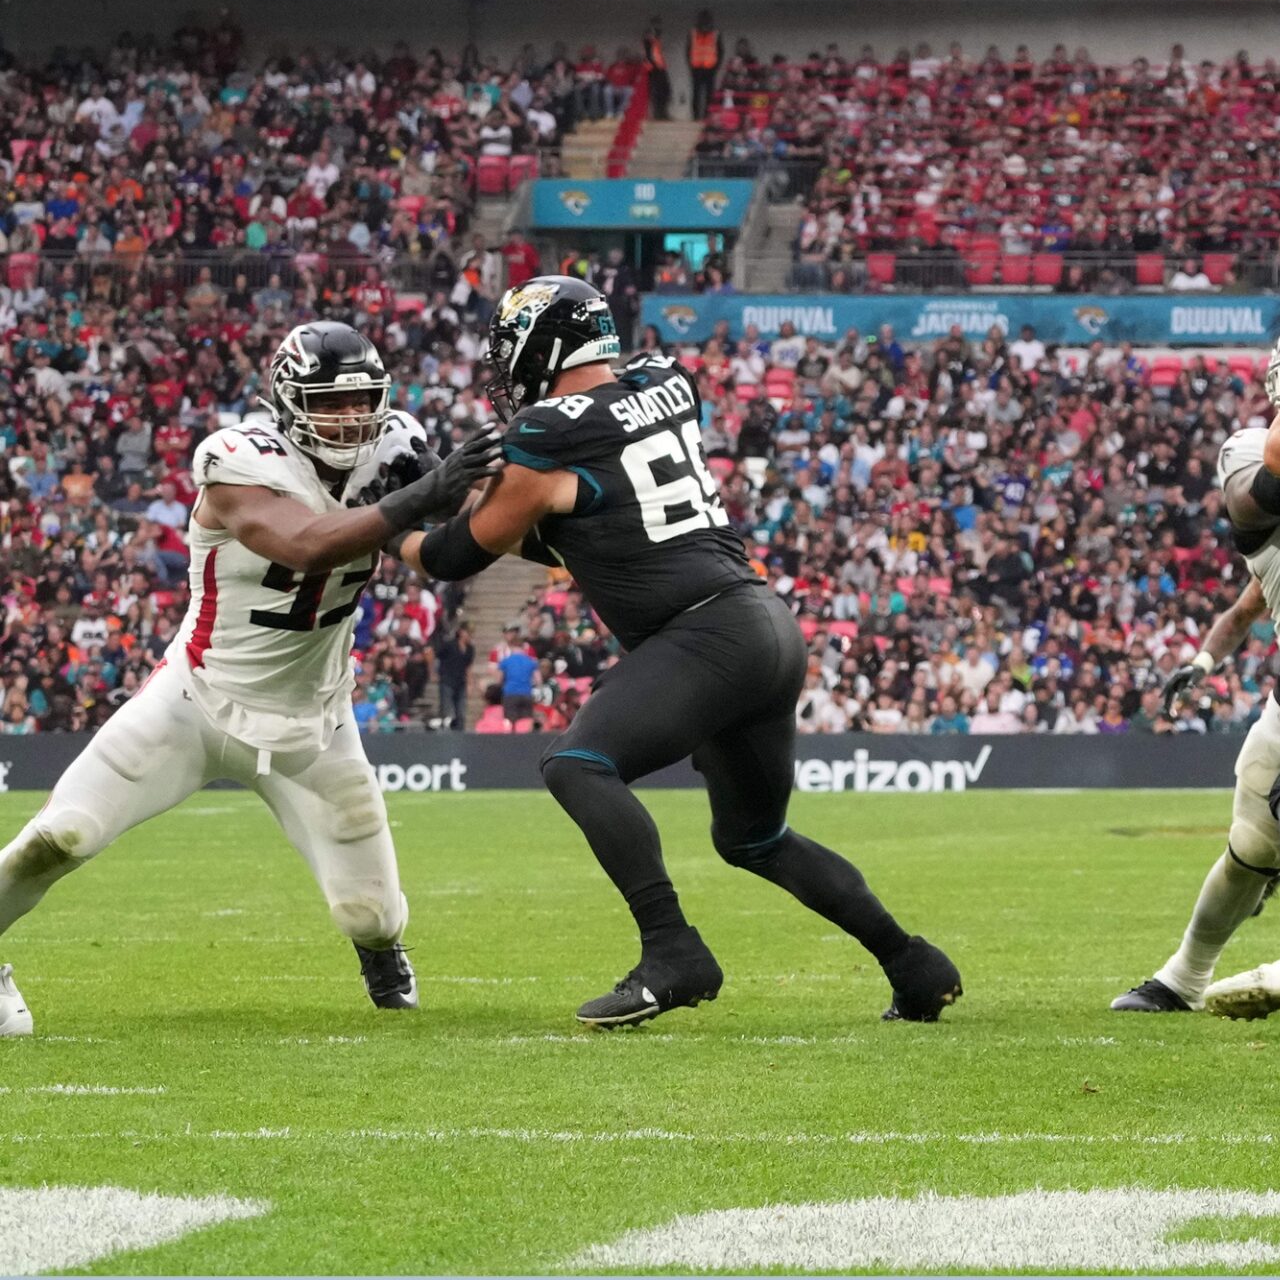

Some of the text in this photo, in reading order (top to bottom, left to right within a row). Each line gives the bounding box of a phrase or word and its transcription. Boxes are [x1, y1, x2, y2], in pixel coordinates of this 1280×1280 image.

[1171, 306, 1265, 334] DUUUVAL
[344, 375, 366, 384] ATL
[608, 374, 696, 433] SHATLEY
[375, 757, 468, 792] port
[795, 748, 966, 792] erizon
